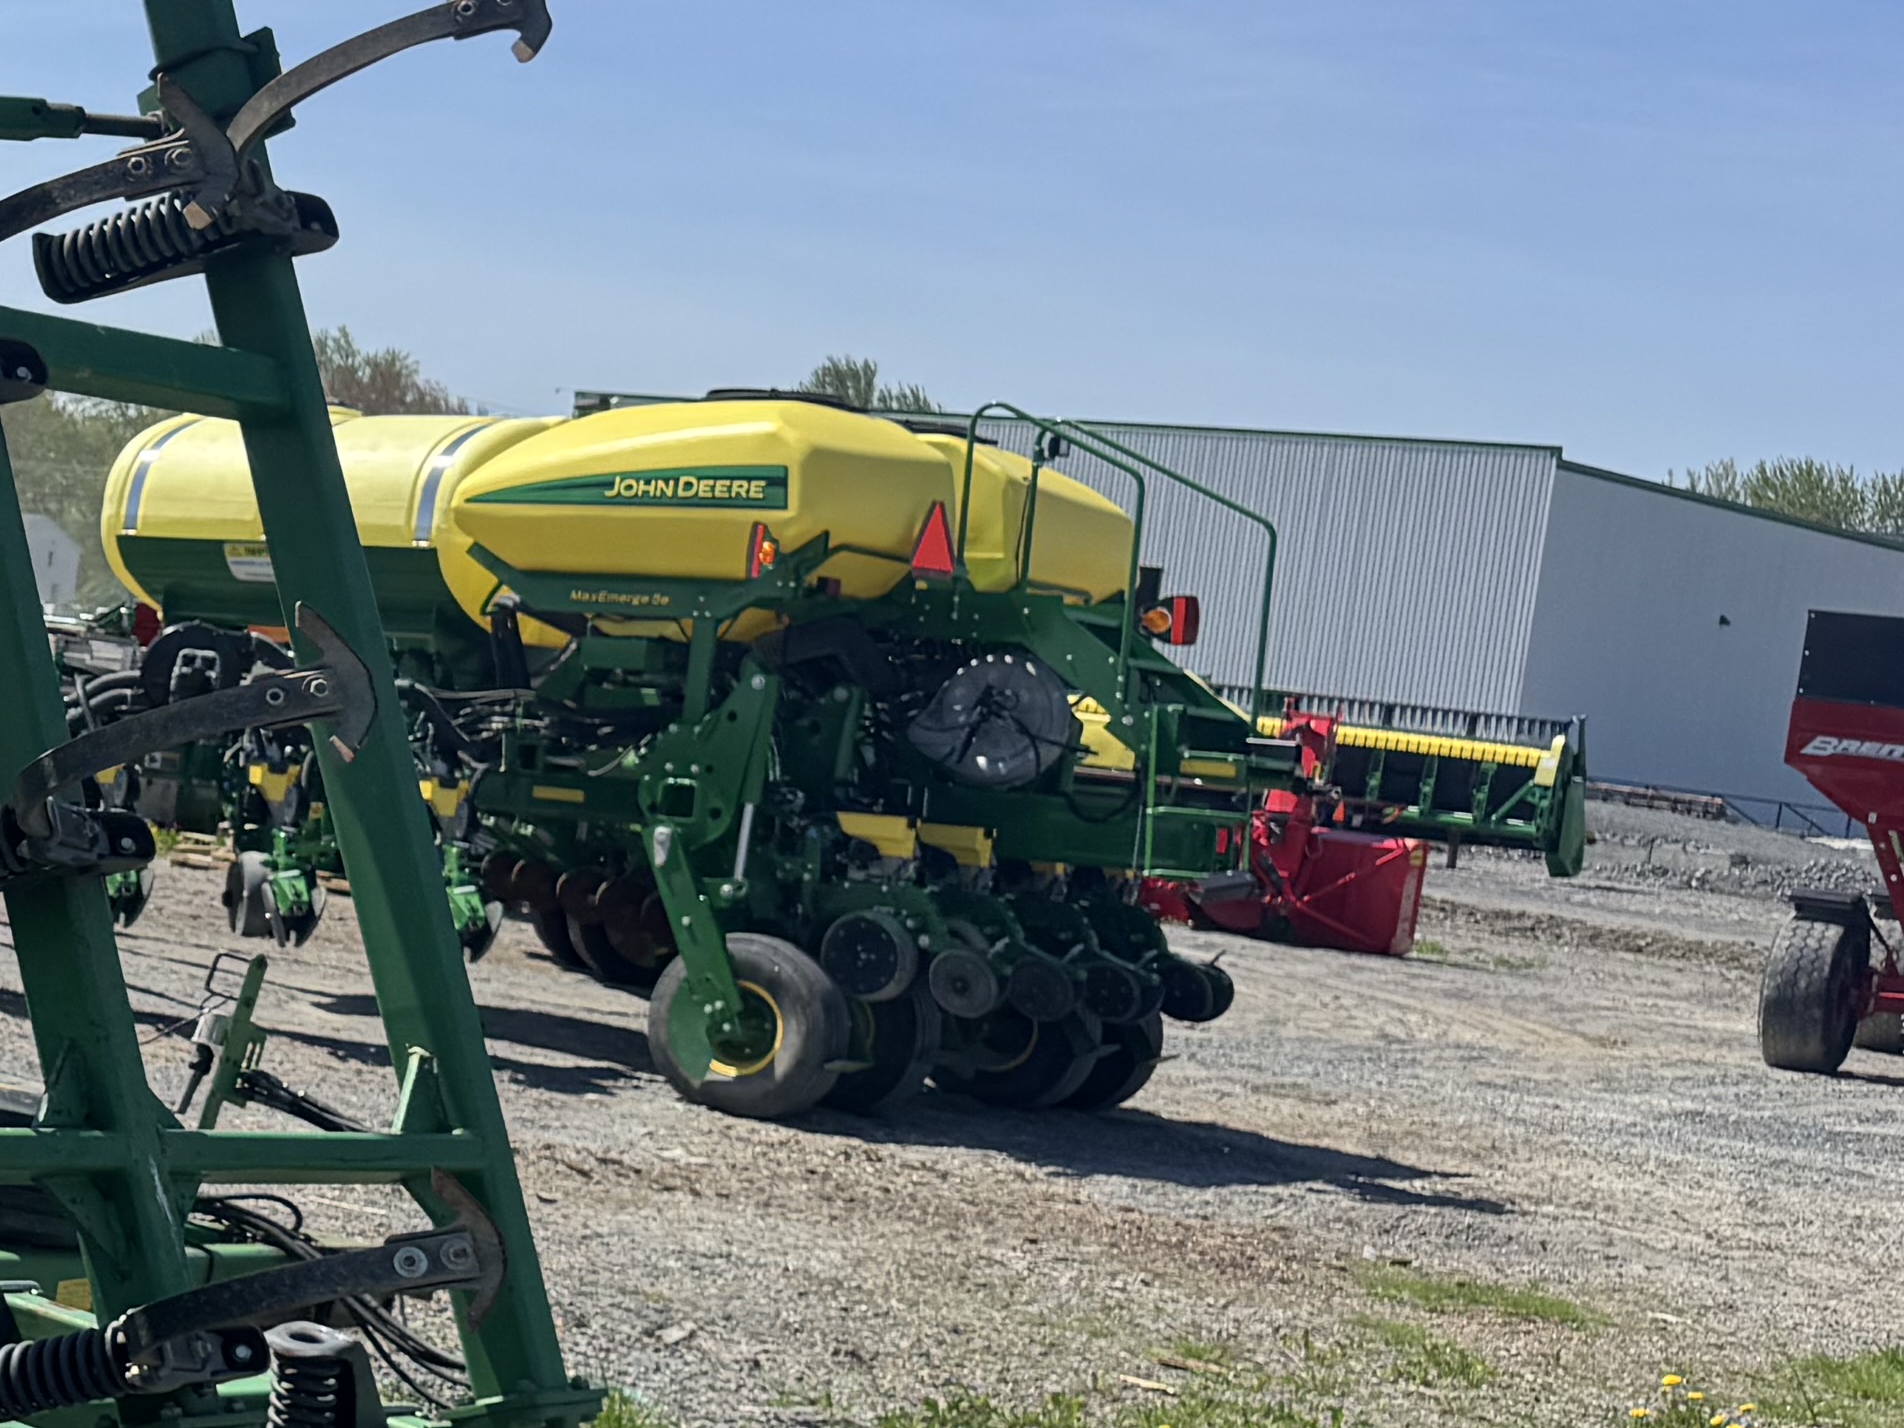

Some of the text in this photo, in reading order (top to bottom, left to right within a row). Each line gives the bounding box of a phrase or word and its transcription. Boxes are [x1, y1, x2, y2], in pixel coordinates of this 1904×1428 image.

[604, 475, 767, 499] JOHN DEERE
[569, 588, 649, 606] MaxEmerge
